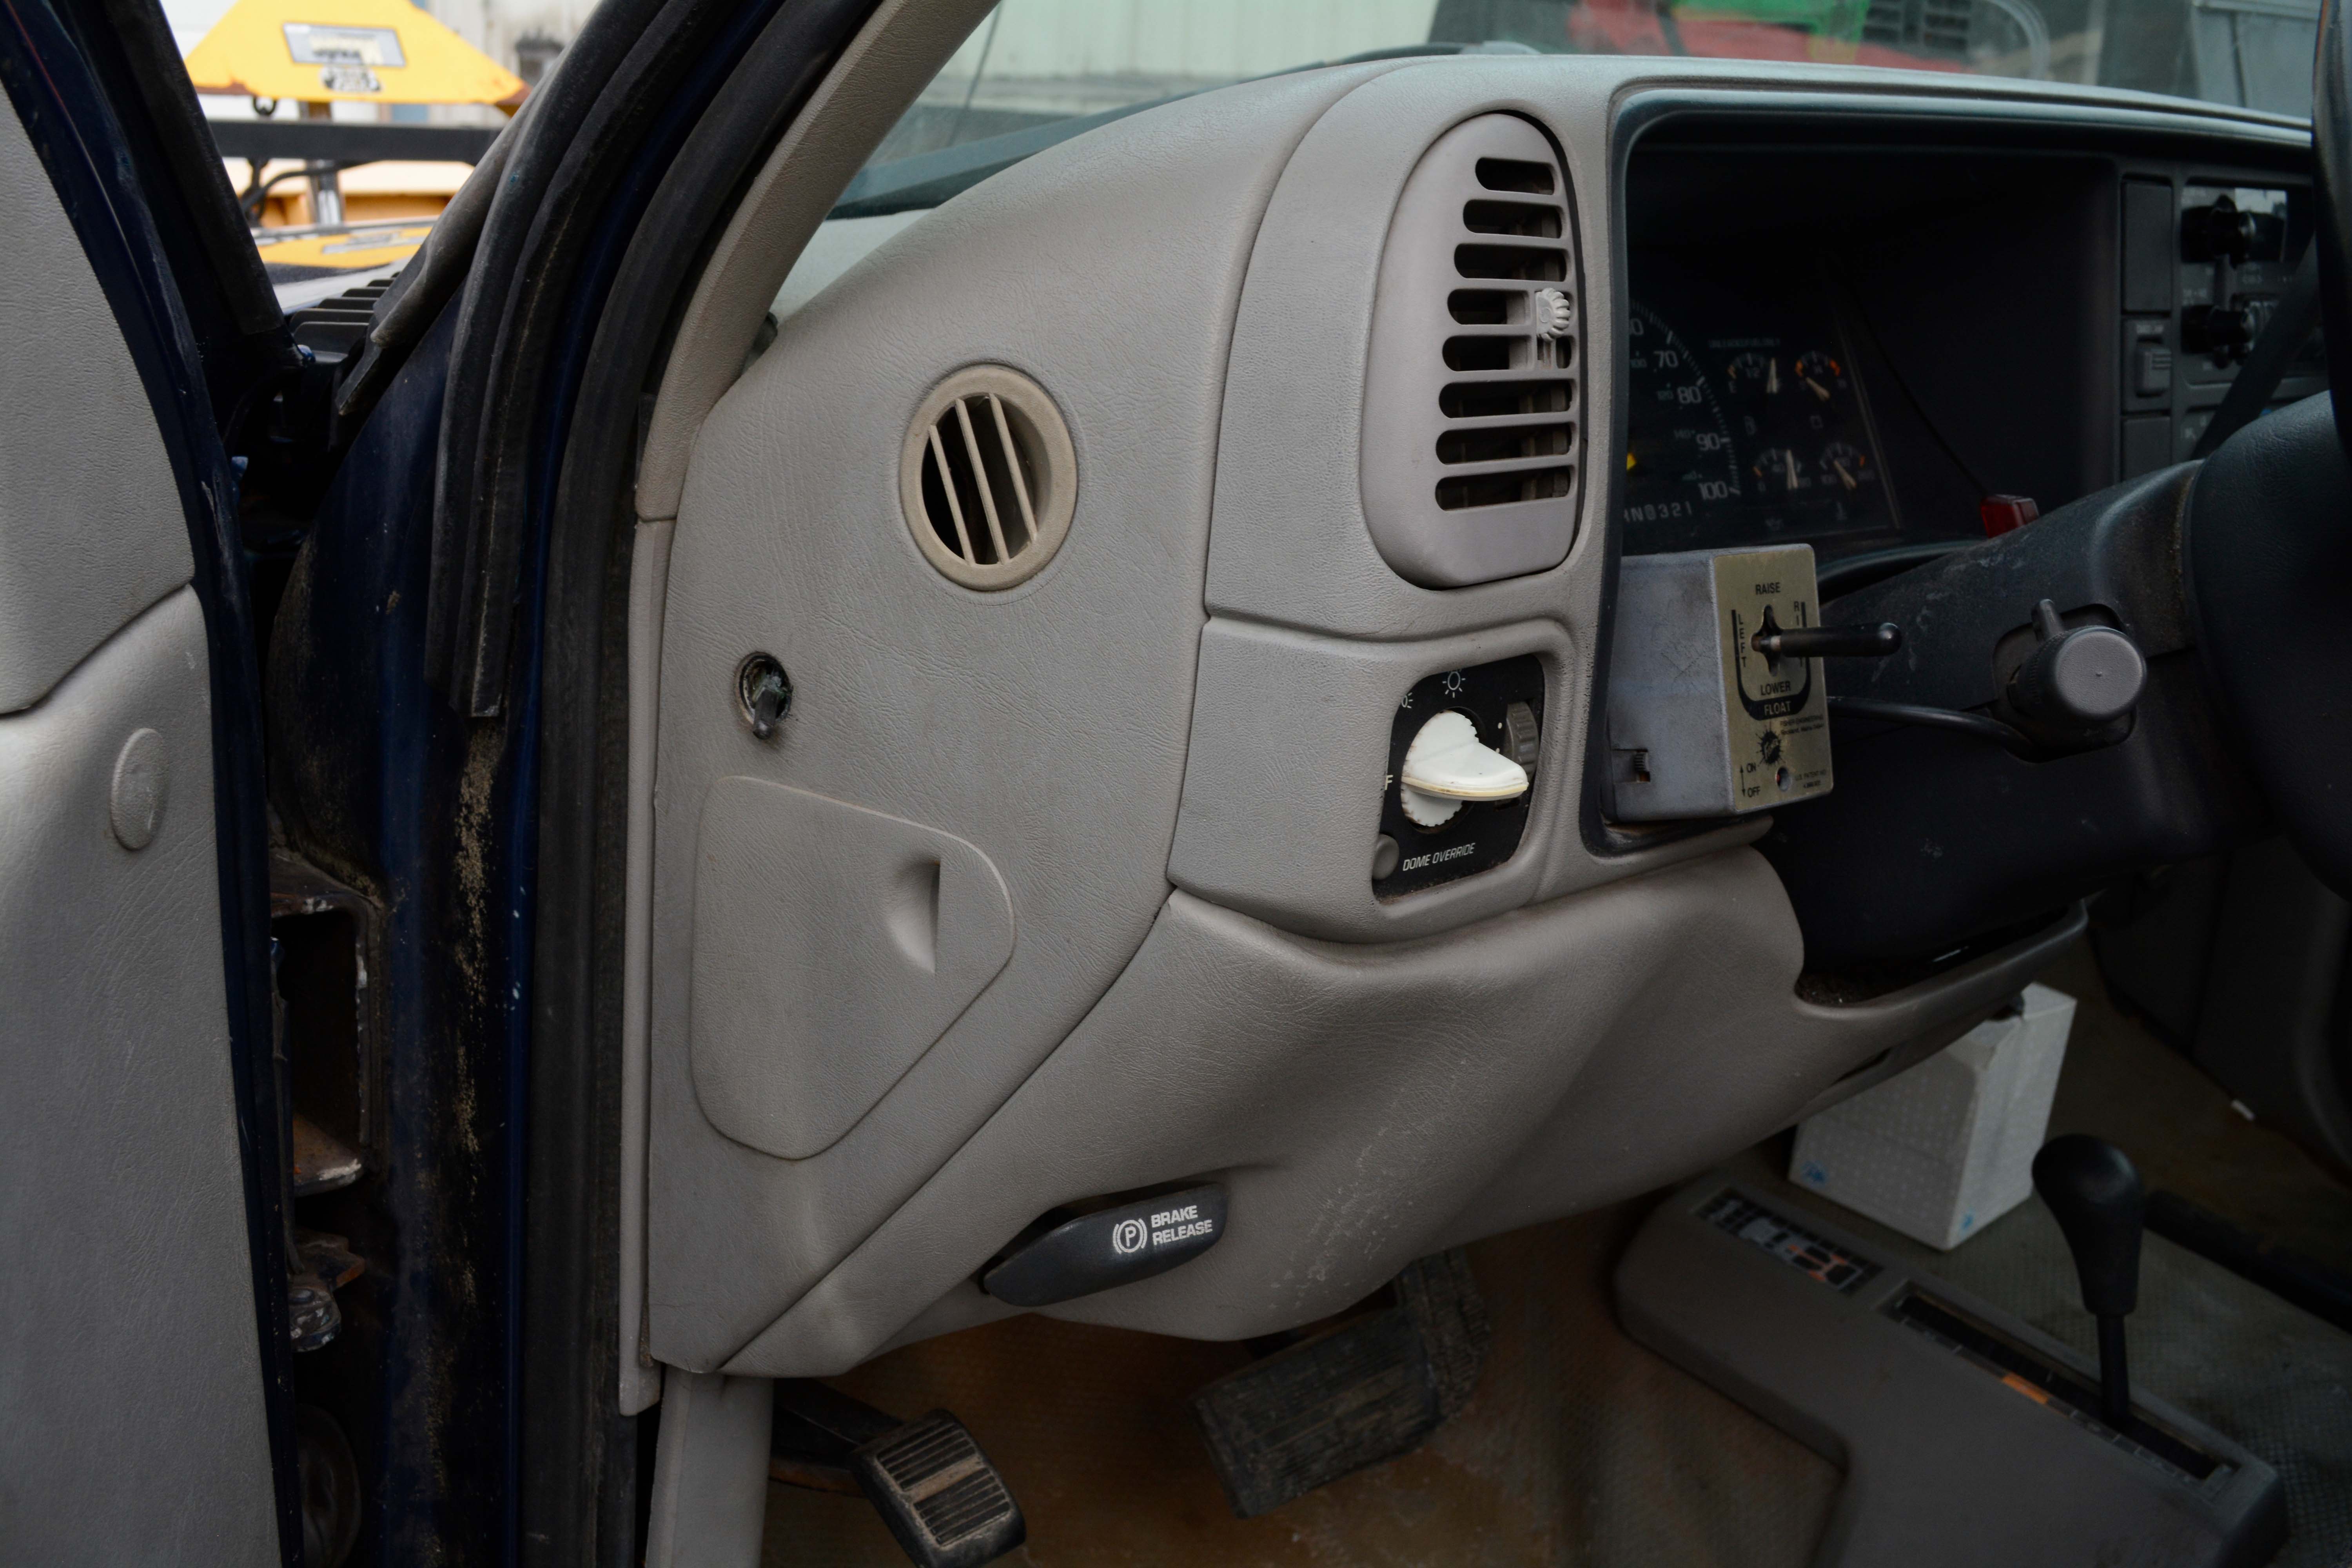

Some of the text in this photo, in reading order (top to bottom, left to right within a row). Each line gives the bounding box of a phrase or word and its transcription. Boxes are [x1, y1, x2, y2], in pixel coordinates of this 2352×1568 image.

[1653, 350, 1679, 368] 70
[1676, 386, 1702, 404] 80
[1696, 433, 1721, 451] 90
[1697, 481, 1728, 501] 100
[1755, 582, 1781, 595] RAISE
[1794, 601, 1803, 667] RIT
[1760, 680, 1791, 696] LOWER
[1764, 700, 1791, 715] FLOAT
[1746, 762, 1757, 773] ON
[1748, 786, 1760, 797] OFF
[1402, 842, 1476, 871] DOME OVERRIDE
[1151, 1205, 1198, 1228] BRAKE
[1152, 1219, 1213, 1245] RELEASE
